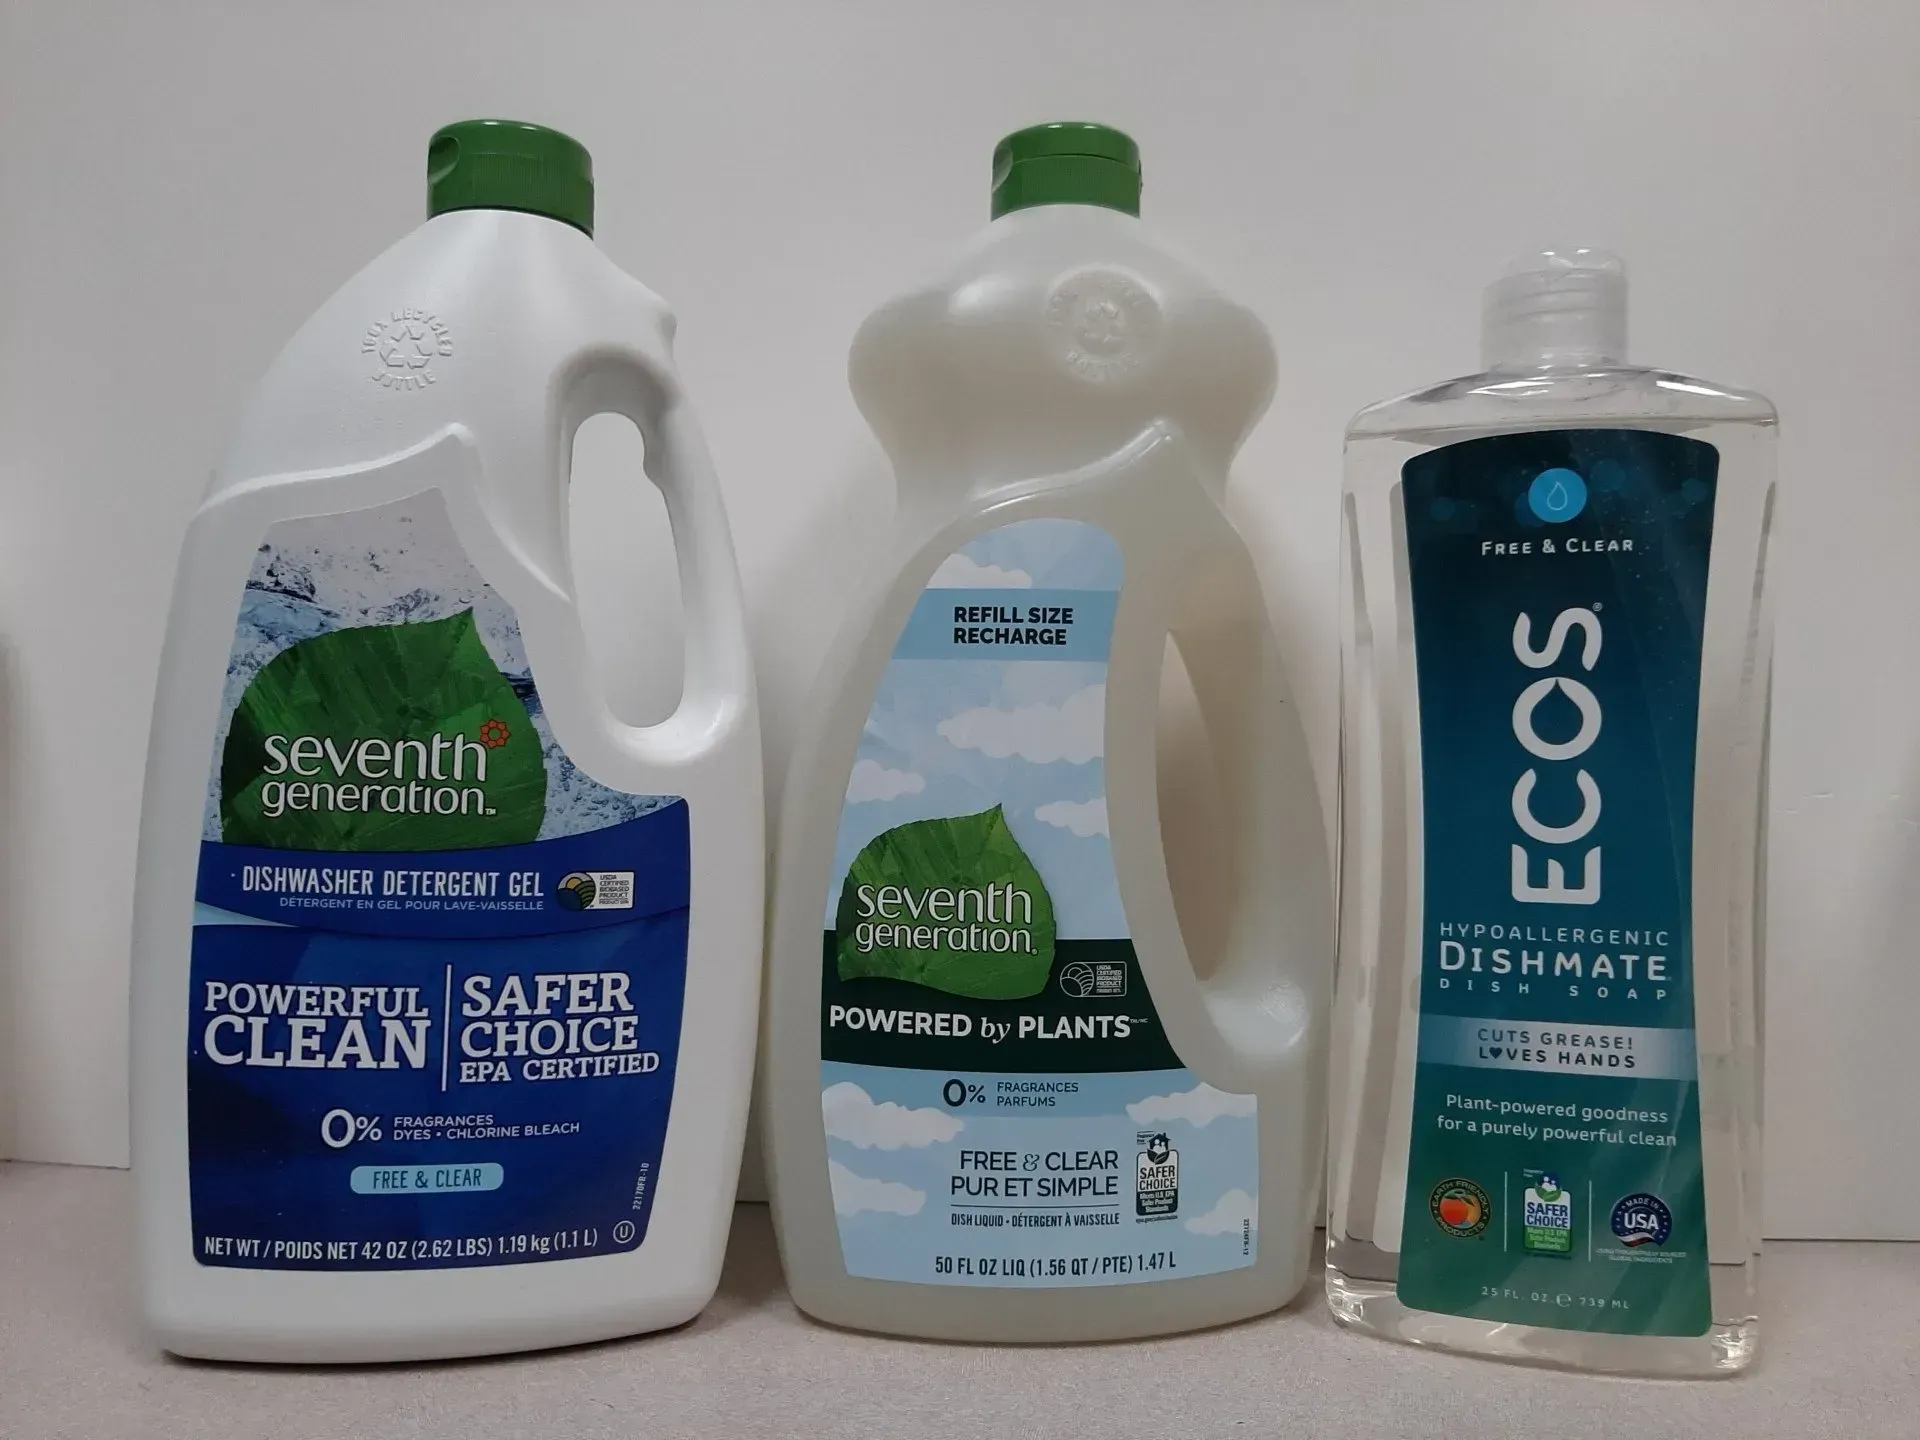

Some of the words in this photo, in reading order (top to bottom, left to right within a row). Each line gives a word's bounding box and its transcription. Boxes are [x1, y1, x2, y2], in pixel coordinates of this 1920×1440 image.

[1482, 540, 1532, 556] FREE
[1542, 539, 1556, 553] &
[1566, 537, 1634, 553] CLEAR
[954, 606, 1024, 623] REFILL
[1028, 607, 1074, 625] SIZE
[953, 628, 1067, 645] RECHARGE
[262, 731, 487, 782] seventh
[1511, 606, 1603, 906] ECOS
[242, 866, 373, 896] DISHWASHER
[383, 870, 500, 897] DETERGENT
[509, 872, 544, 897] GEL
[280, 896, 352, 909] DÉTERGENT
[357, 900, 375, 909] EN
[377, 900, 402, 910] GEL
[405, 900, 440, 910] POUR
[444, 901, 544, 911] LAVE-VAISSELLE
[856, 882, 1032, 924] seventh
[1440, 922, 1669, 946] HYPOALLERGENIC
[1440, 941, 1667, 981] DISHMATE
[204, 981, 429, 1018] POWERFUL
[462, 972, 635, 1017] SAFER
[1440, 978, 1529, 994] DISH
[1569, 985, 1666, 1000] SOAP
[829, 1004, 972, 1038] POWERED
[980, 1016, 1011, 1044] by
[1019, 1015, 1131, 1039] PLANTS
[204, 1016, 432, 1069] CLEAN
[460, 1015, 639, 1057] CHOICE
[1478, 1028, 1531, 1044] CUTS
[1541, 1032, 1632, 1050] GREASE!
[459, 1060, 511, 1083] EPA
[522, 1052, 660, 1081] CERTIFIED
[1558, 1051, 1636, 1068] HANDS
[943, 1079, 986, 1107] 0%
[997, 1082, 1079, 1092] FRAGRANCES
[997, 1096, 1056, 1107] PARFUMS
[1446, 1094, 1576, 1117] Plant-powered
[1582, 1107, 1668, 1123] goodness
[321, 1108, 382, 1148] 0%
[394, 1115, 494, 1128] FRAGRANCES
[394, 1129, 431, 1140] DYES
[446, 1126, 520, 1140] CHLORINE
[524, 1122, 580, 1136] BLEACH
[1437, 1115, 1463, 1130] for
[1467, 1121, 1477, 1132] a
[1482, 1122, 1538, 1140] purely
[1543, 1126, 1624, 1144] powerful
[1629, 1131, 1677, 1146] clean
[960, 1150, 1017, 1171] FREE
[1022, 1153, 1040, 1171] &
[1045, 1150, 1119, 1171] CLEAR
[373, 1169, 408, 1189] FREE
[414, 1171, 429, 1188] &
[436, 1168, 481, 1187] CLEAR
[1140, 1165, 1175, 1180] SAFER
[951, 1175, 999, 1196] PUR
[1004, 1178, 1033, 1197] ET
[1037, 1175, 1119, 1197] SIMPLE
[1139, 1178, 1176, 1191] CHOICE
[1527, 1202, 1568, 1217] SAFER
[1625, 1197, 1650, 1207] MADE
[1650, 1201, 1660, 1209] IN
[951, 1213, 973, 1225] DISH
[974, 1214, 1003, 1227] LIQUID
[1011, 1213, 1063, 1227] DÉTERGENT
[1065, 1212, 1071, 1226] À
[1074, 1213, 1120, 1226] VAISSELLE
[1526, 1214, 1568, 1228] CHOICE
[1623, 1212, 1659, 1230] USA
[205, 1236, 233, 1256] NET
[236, 1239, 260, 1257] WT
[263, 1239, 271, 1258] /
[274, 1241, 323, 1260] POIDS
[327, 1242, 358, 1260] NET
[361, 1242, 381, 1259] 42
[386, 1241, 406, 1258] OZ
[411, 1240, 451, 1260] (2.62
[457, 1237, 492, 1257] LBS)
[499, 1235, 526, 1254] 1.19
[531, 1234, 550, 1253] kg
[554, 1229, 578, 1251] (1.1
[584, 1228, 598, 1248] L)
[935, 1256, 952, 1273] 50
[958, 1257, 974, 1275] FL
[979, 1258, 997, 1275] OZ
[1003, 1259, 1025, 1276] LIQ
[1030, 1258, 1066, 1277] (1.56
[1071, 1258, 1088, 1275] QT
[1091, 1257, 1099, 1275] /
[1102, 1255, 1132, 1274] PTE)
[1137, 1252, 1165, 1271] 1.47
[1169, 1251, 1176, 1268] L
[1481, 1286, 1498, 1297] 25
[1579, 1297, 1605, 1308] 739
[1611, 1300, 1629, 1309] ML
